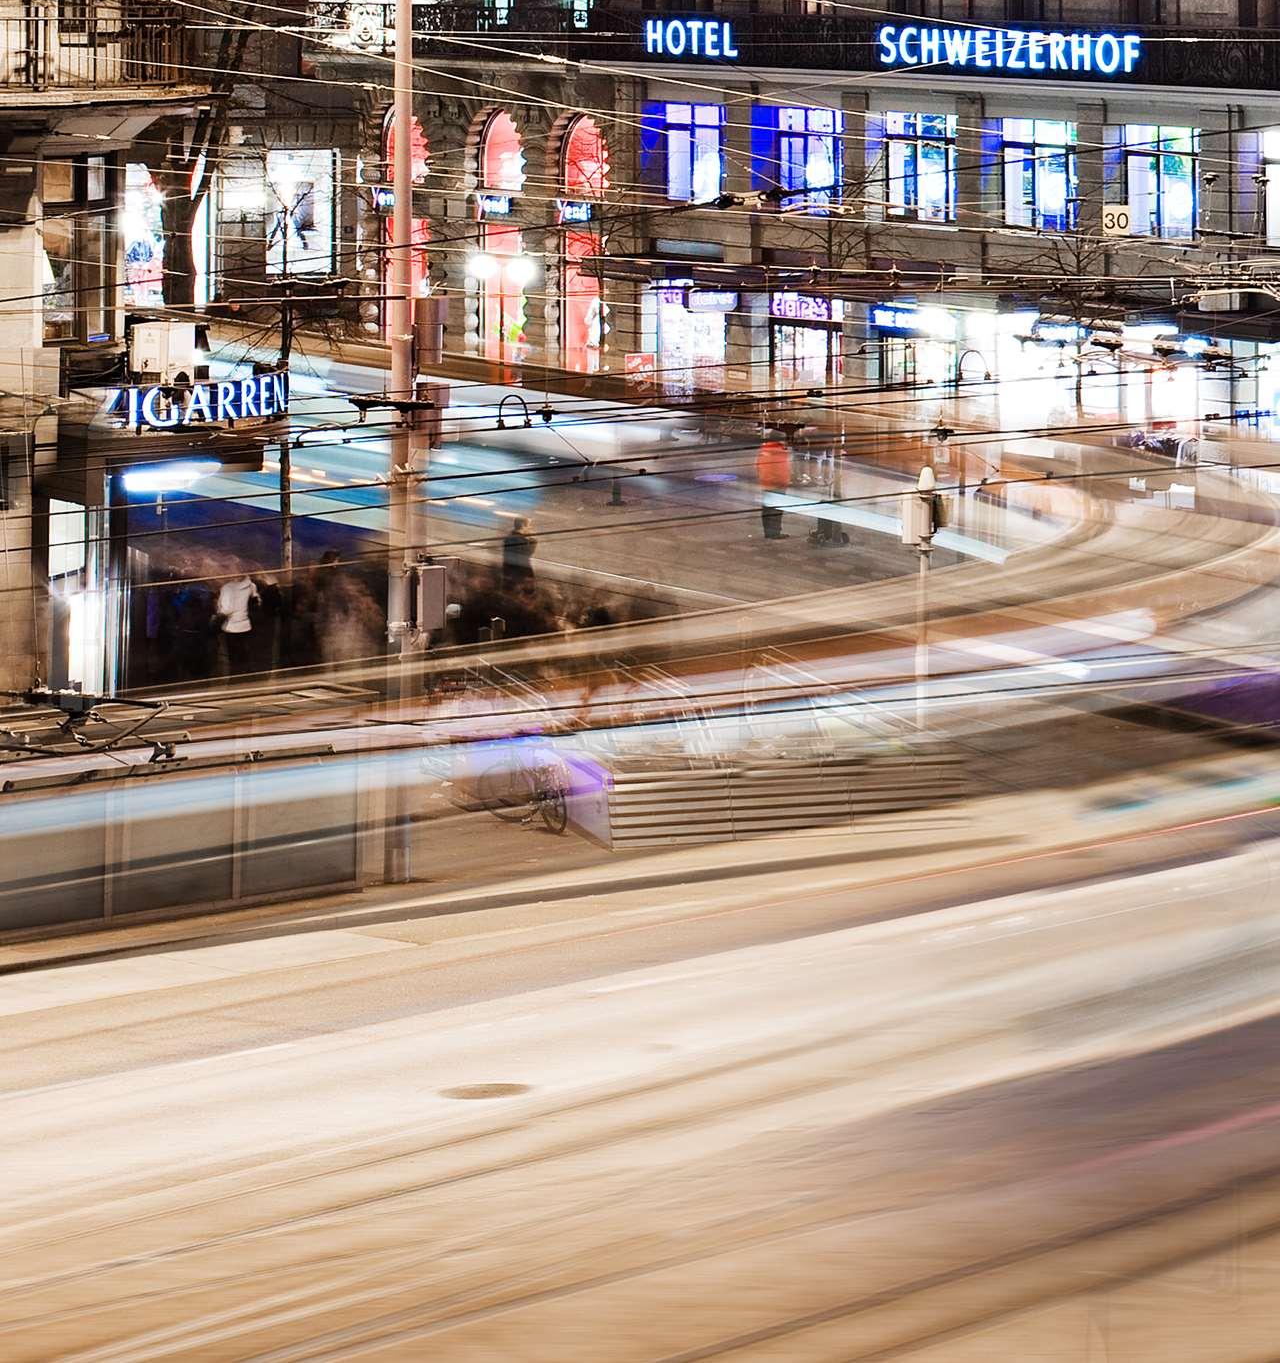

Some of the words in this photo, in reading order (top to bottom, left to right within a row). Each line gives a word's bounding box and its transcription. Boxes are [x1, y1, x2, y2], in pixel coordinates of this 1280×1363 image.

[645, 19, 738, 57] HOTEL
[879, 26, 1142, 73] SCHWEIZERHOF
[371, 186, 395, 209] Yen
[476, 193, 510, 221] Yendi
[1104, 212, 1129, 230] 30
[105, 372, 290, 429] ZIGARREN
